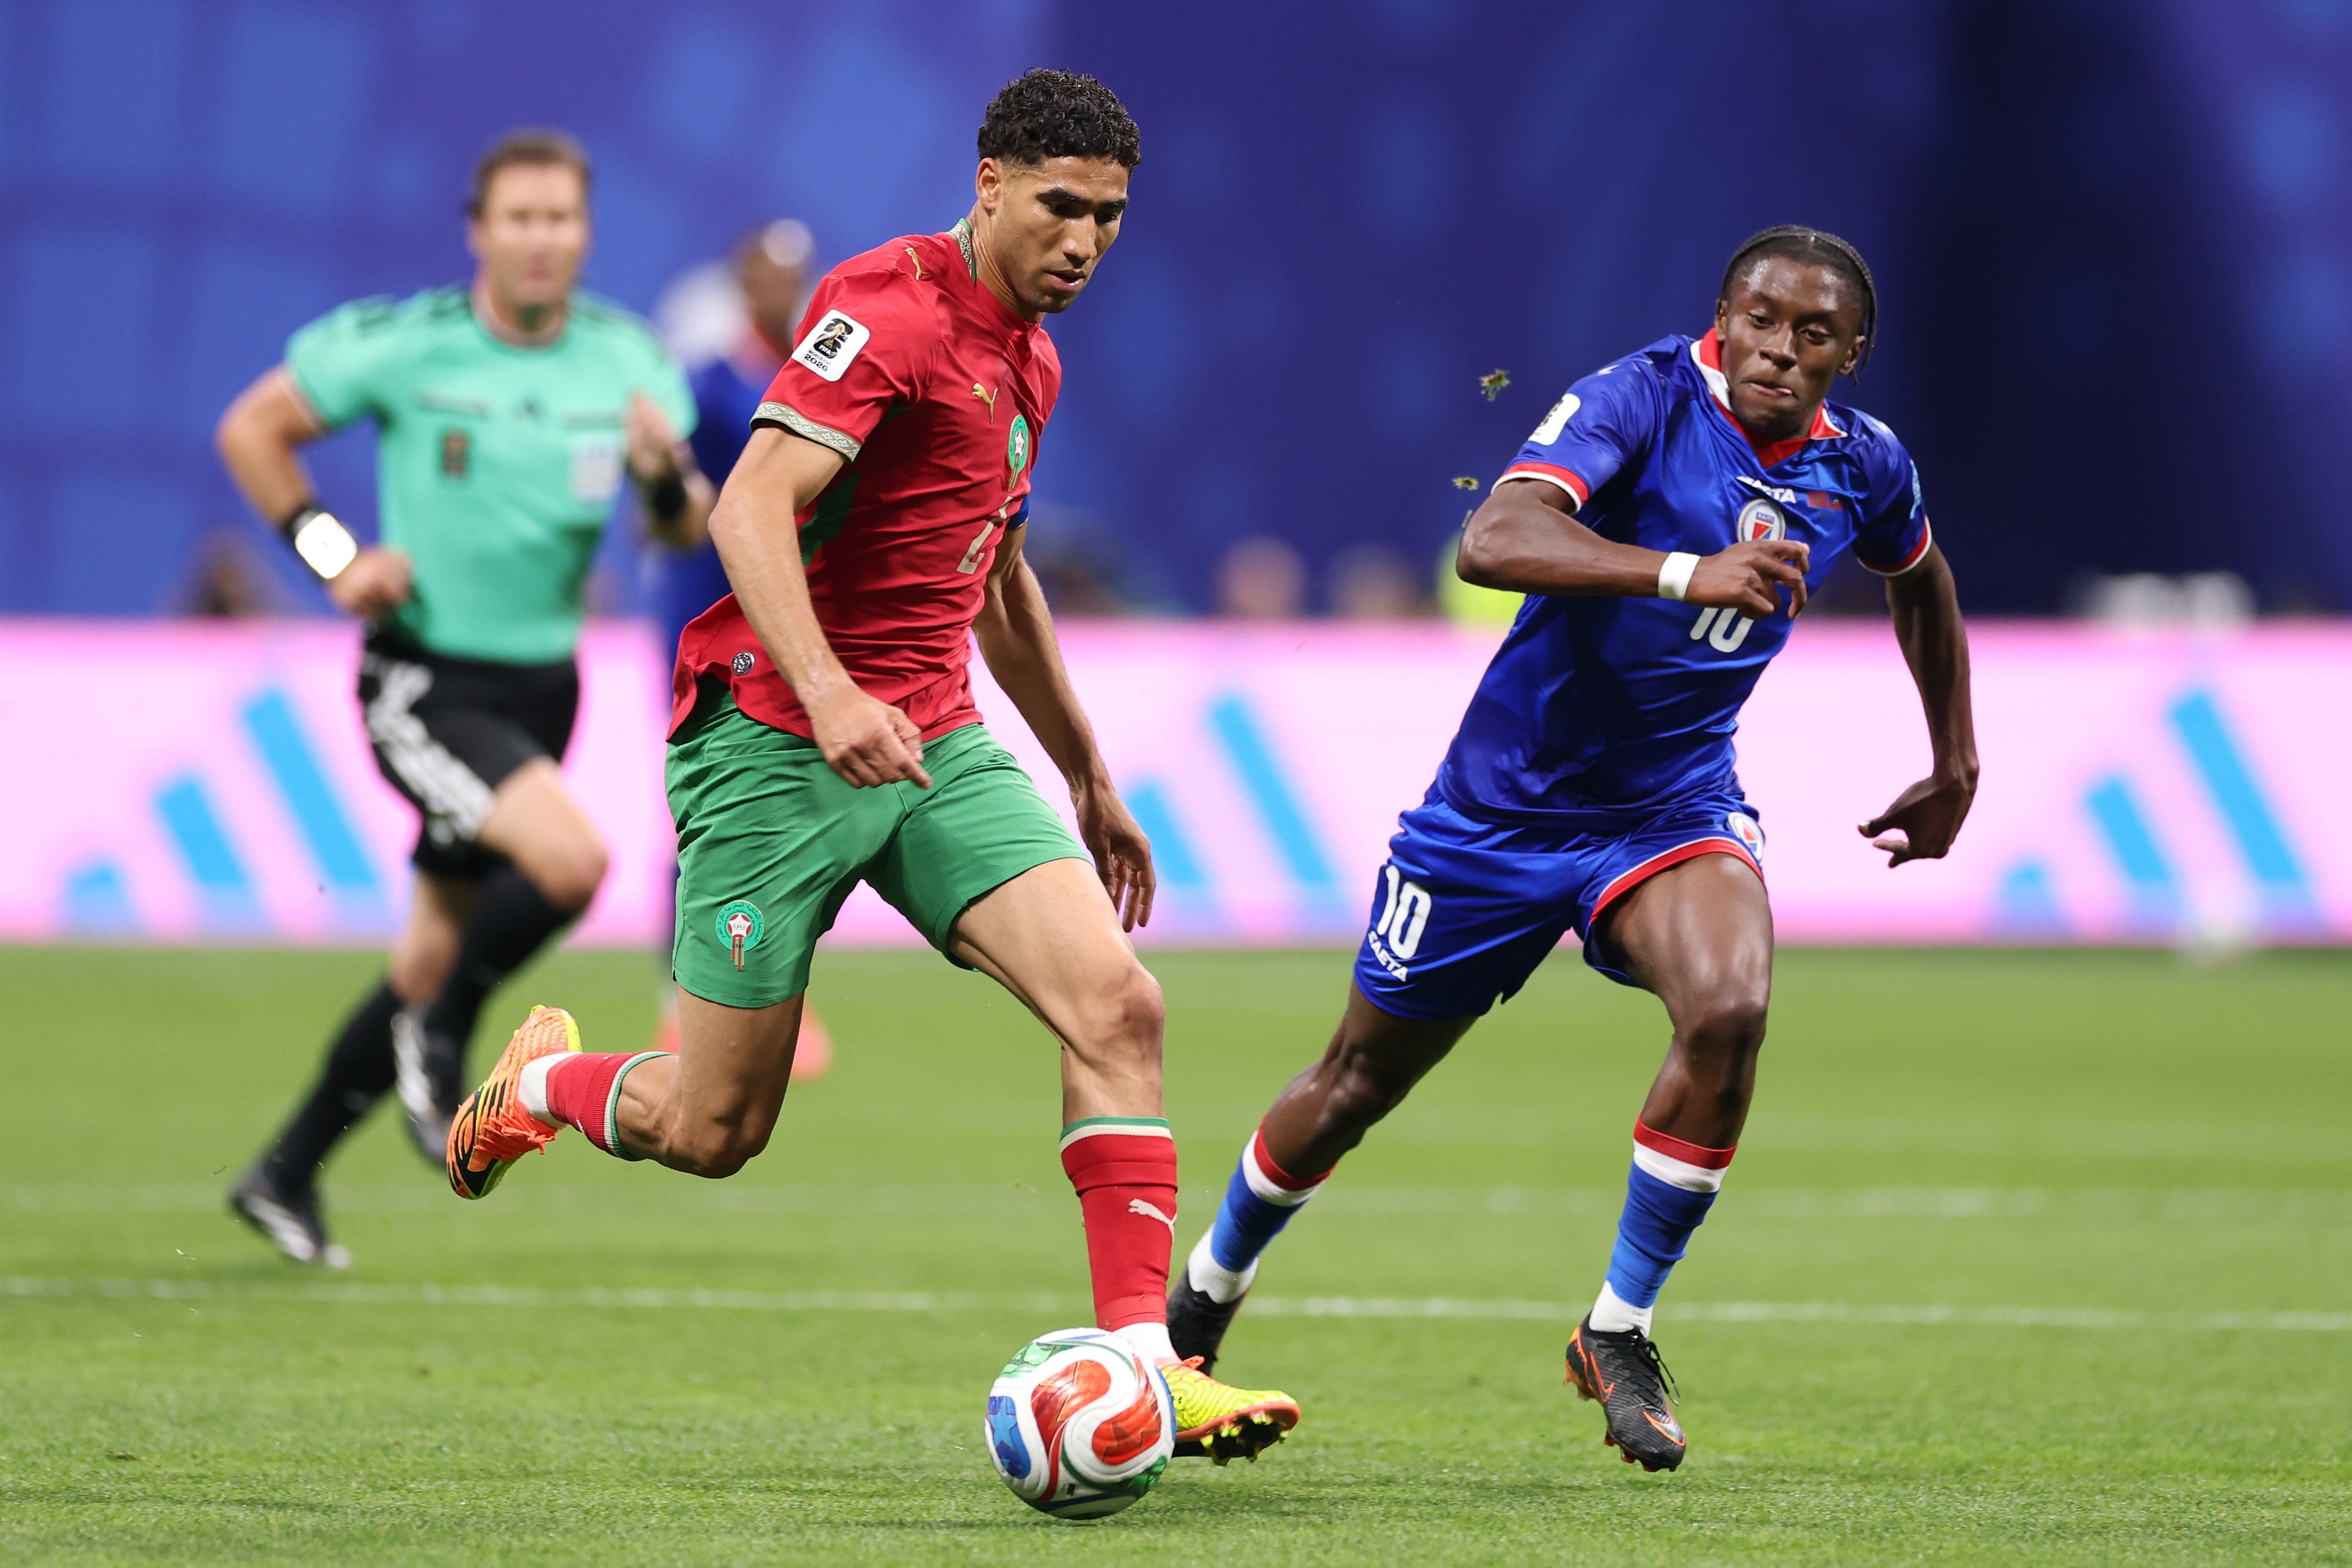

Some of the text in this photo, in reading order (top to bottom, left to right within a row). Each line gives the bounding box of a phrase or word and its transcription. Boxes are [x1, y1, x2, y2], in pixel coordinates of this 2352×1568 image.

[805, 354, 828, 371] 2026
[819, 345, 831, 355] FIFA
[1377, 865, 1432, 960] 10
[1368, 930, 1408, 982] SAETA
